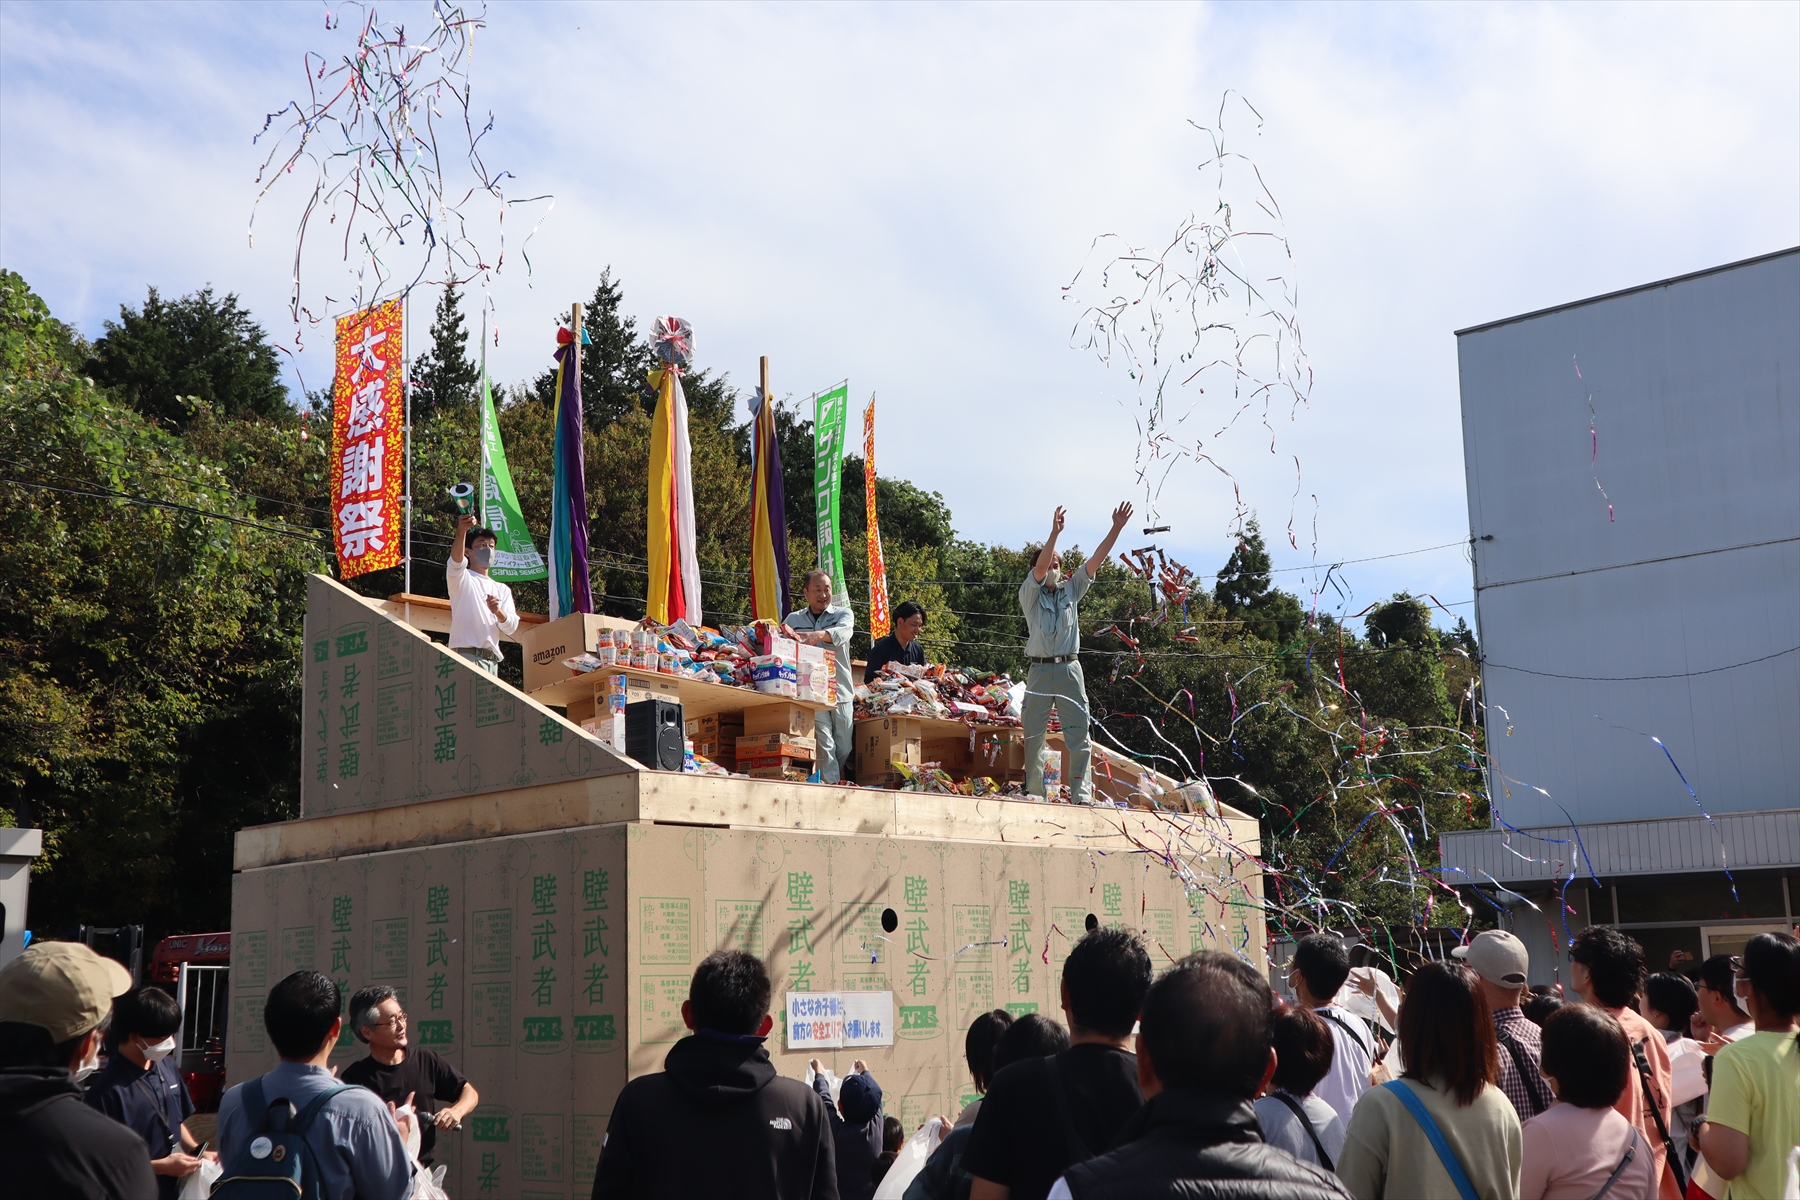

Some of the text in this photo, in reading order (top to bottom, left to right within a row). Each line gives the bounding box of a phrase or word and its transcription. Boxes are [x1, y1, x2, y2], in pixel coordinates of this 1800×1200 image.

[338, 327, 386, 560] 大感謝祭
[533, 644, 566, 663] amazon
[169, 940, 187, 949] UNIC
[425, 884, 449, 1011] 壁武者
[531, 873, 557, 1007] 壁武者
[582, 868, 609, 1005] 壁武者
[903, 875, 931, 997] 壁武者
[1008, 878, 1033, 994] 壁武者
[523, 1017, 565, 1042] TBG
[574, 1015, 617, 1041] TBG
[899, 1005, 939, 1029] TBG
